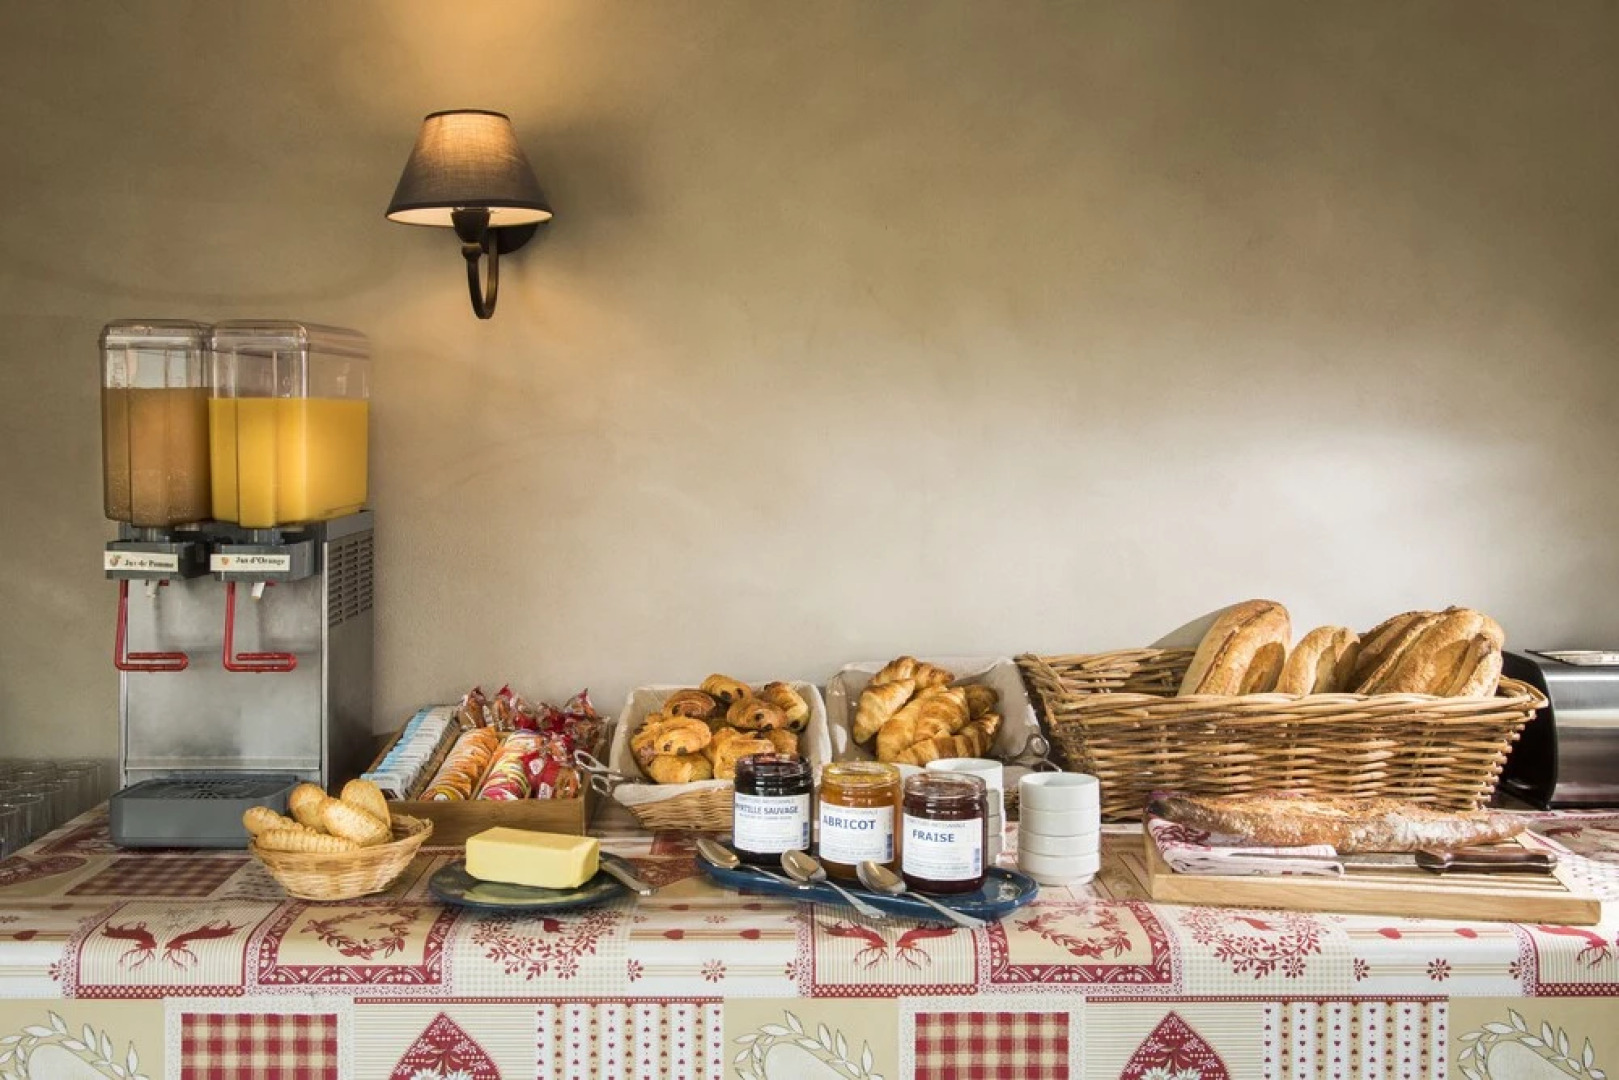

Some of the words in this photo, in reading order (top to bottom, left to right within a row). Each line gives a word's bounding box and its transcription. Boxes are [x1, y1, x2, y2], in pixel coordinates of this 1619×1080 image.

[763, 805, 799, 815] SAUVAGE
[823, 815, 877, 830] ABRICOT
[912, 828, 955, 843] FRAISE
